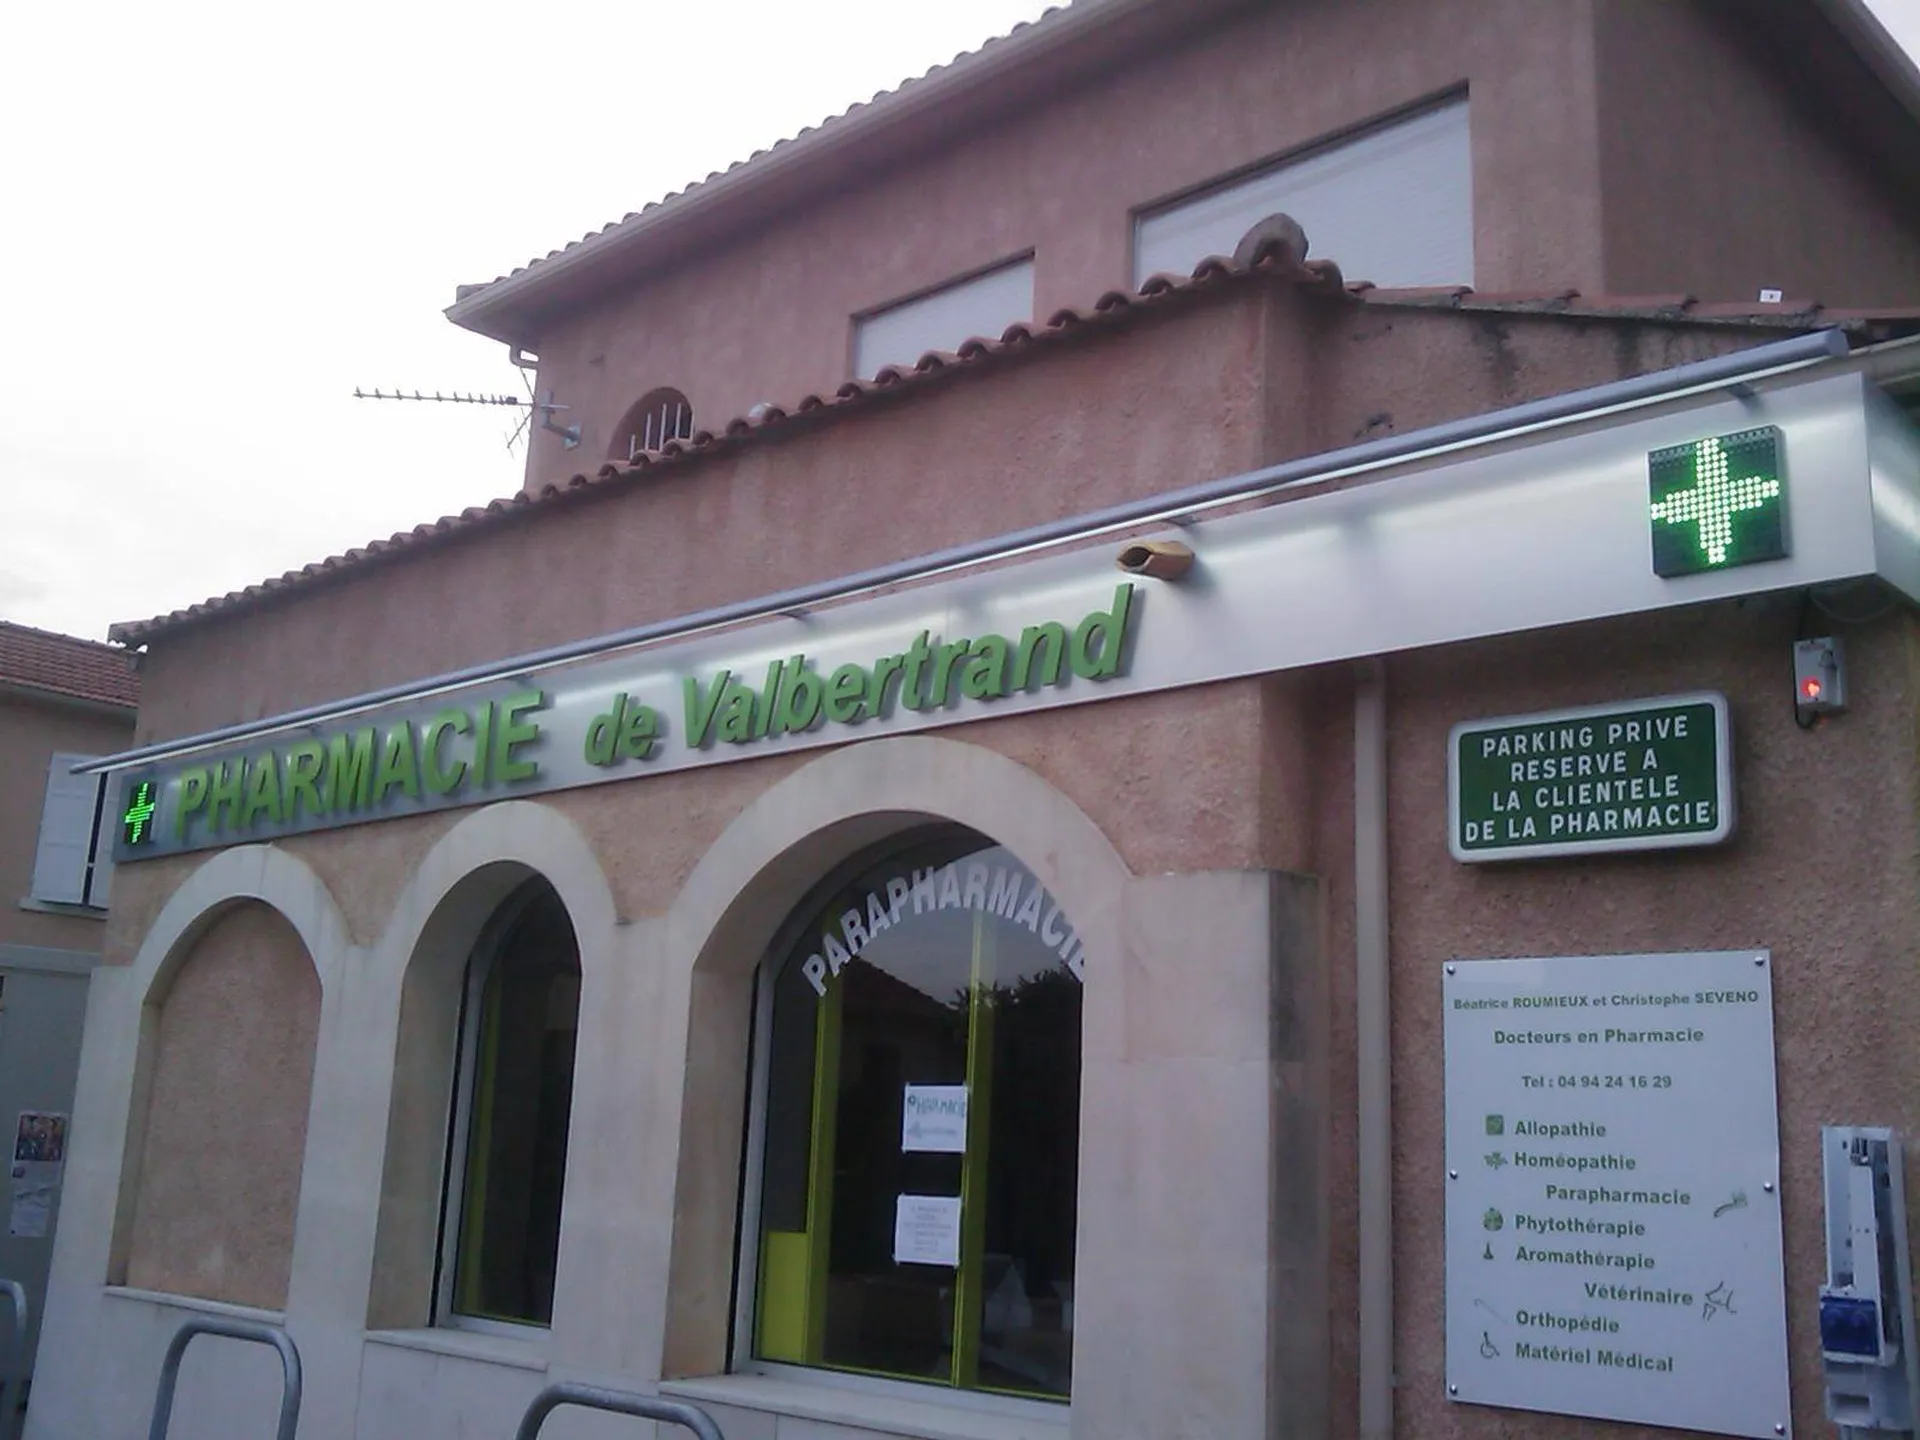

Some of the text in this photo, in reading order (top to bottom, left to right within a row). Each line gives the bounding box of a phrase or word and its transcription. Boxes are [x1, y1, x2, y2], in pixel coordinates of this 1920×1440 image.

[173, 583, 1134, 840] PHARMACIE de Valbertrand
[1482, 715, 1689, 758] PARKING PRIVE
[1510, 748, 1659, 783] RESERVE A
[1492, 774, 1680, 812] LA CLIENTELE
[1465, 801, 1711, 843] DE LA PHARMACIE
[1512, 995, 1589, 1009] ROUMIEUX
[1592, 997, 1608, 1008] et
[1611, 993, 1691, 1008] Christophe
[1694, 990, 1760, 1005] SEVENO
[1494, 1027, 1705, 1045] Docteurs en Pharmacie
[1522, 1075, 1545, 1088] Tel
[1558, 1075, 1576, 1088] 04
[1581, 1075, 1600, 1088] 94
[1605, 1075, 1624, 1088] 24
[1629, 1075, 1647, 1088] 16
[1653, 1075, 1672, 1088] 29
[1514, 1120, 1607, 1139] Allopathie
[1514, 1152, 1637, 1172] Homéopathie
[1545, 1184, 1692, 1206] Parapharmacie
[1515, 1214, 1646, 1238] Phytothérapie
[1515, 1246, 1656, 1272] Aromathérapie
[1584, 1282, 1694, 1306] Vétérinaire
[1515, 1310, 1620, 1333] Orthopédie
[1515, 1342, 1674, 1372] Matériel Médical
